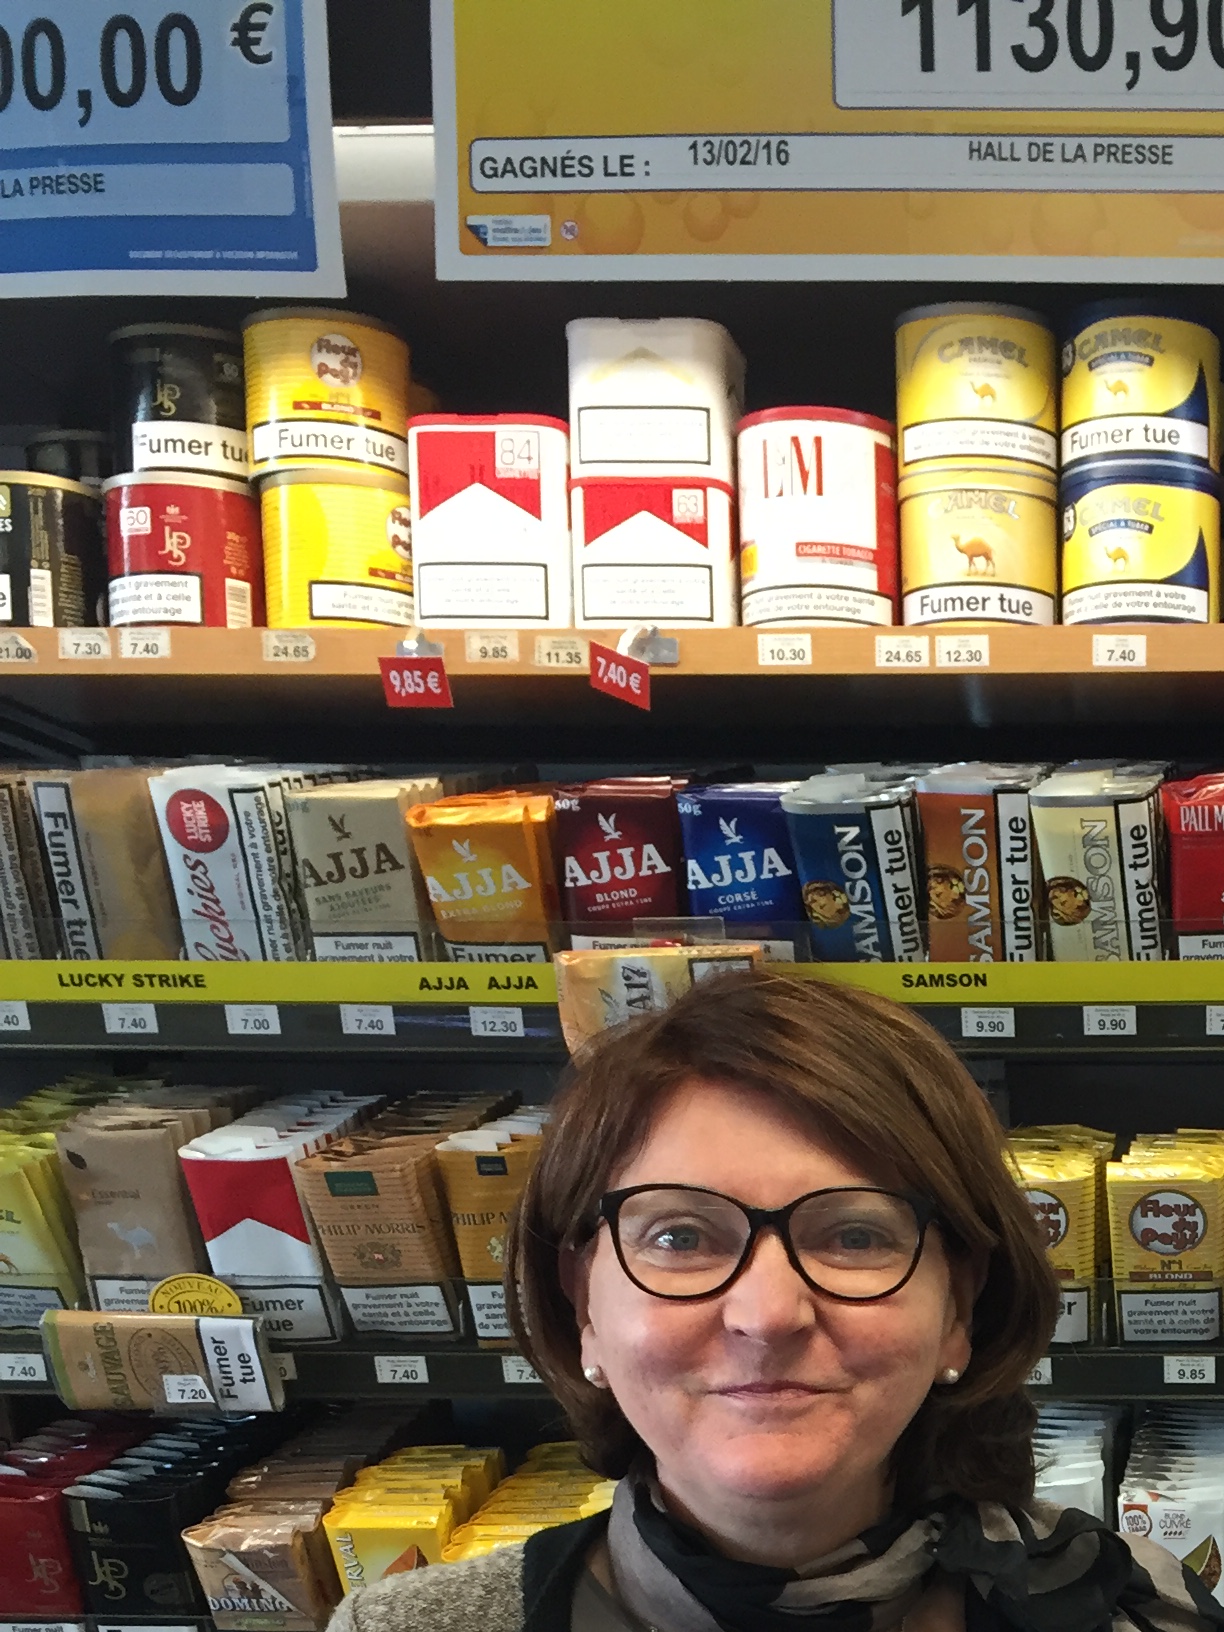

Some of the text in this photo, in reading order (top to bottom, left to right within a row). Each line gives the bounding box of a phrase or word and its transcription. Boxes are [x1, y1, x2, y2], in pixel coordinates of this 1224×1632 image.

[479, 139, 1174, 181] GAGNÉS LE 13/02/16 HALL DE LA PRESSE
[1, 173, 106, 198] LA PRESSE
[278, 429, 396, 461] Fumer tue
[1069, 424, 1180, 452] Fumer tue
[130, 642, 159, 656] 7.40
[769, 648, 806, 662] 10.30
[945, 650, 982, 663] 12.30
[1180, 805, 1212, 832] PALL
[302, 843, 405, 888] AJJA
[565, 845, 671, 888] AJJA
[687, 848, 792, 890] AJJA
[596, 888, 638, 903] BLOND
[58, 973, 207, 988] LUCKY STRIKE
[418, 975, 539, 991] AJJA AJJA
[901, 973, 988, 988] SAMSON
[118, 1017, 147, 1030] 7.40
[242, 1018, 270, 1030] 7.00
[481, 1019, 518, 1033] 12.30
[1098, 1018, 1127, 1032] 9.90
[1177, 1367, 1206, 1381] 9.85
[177, 1388, 207, 1401] 7.20
